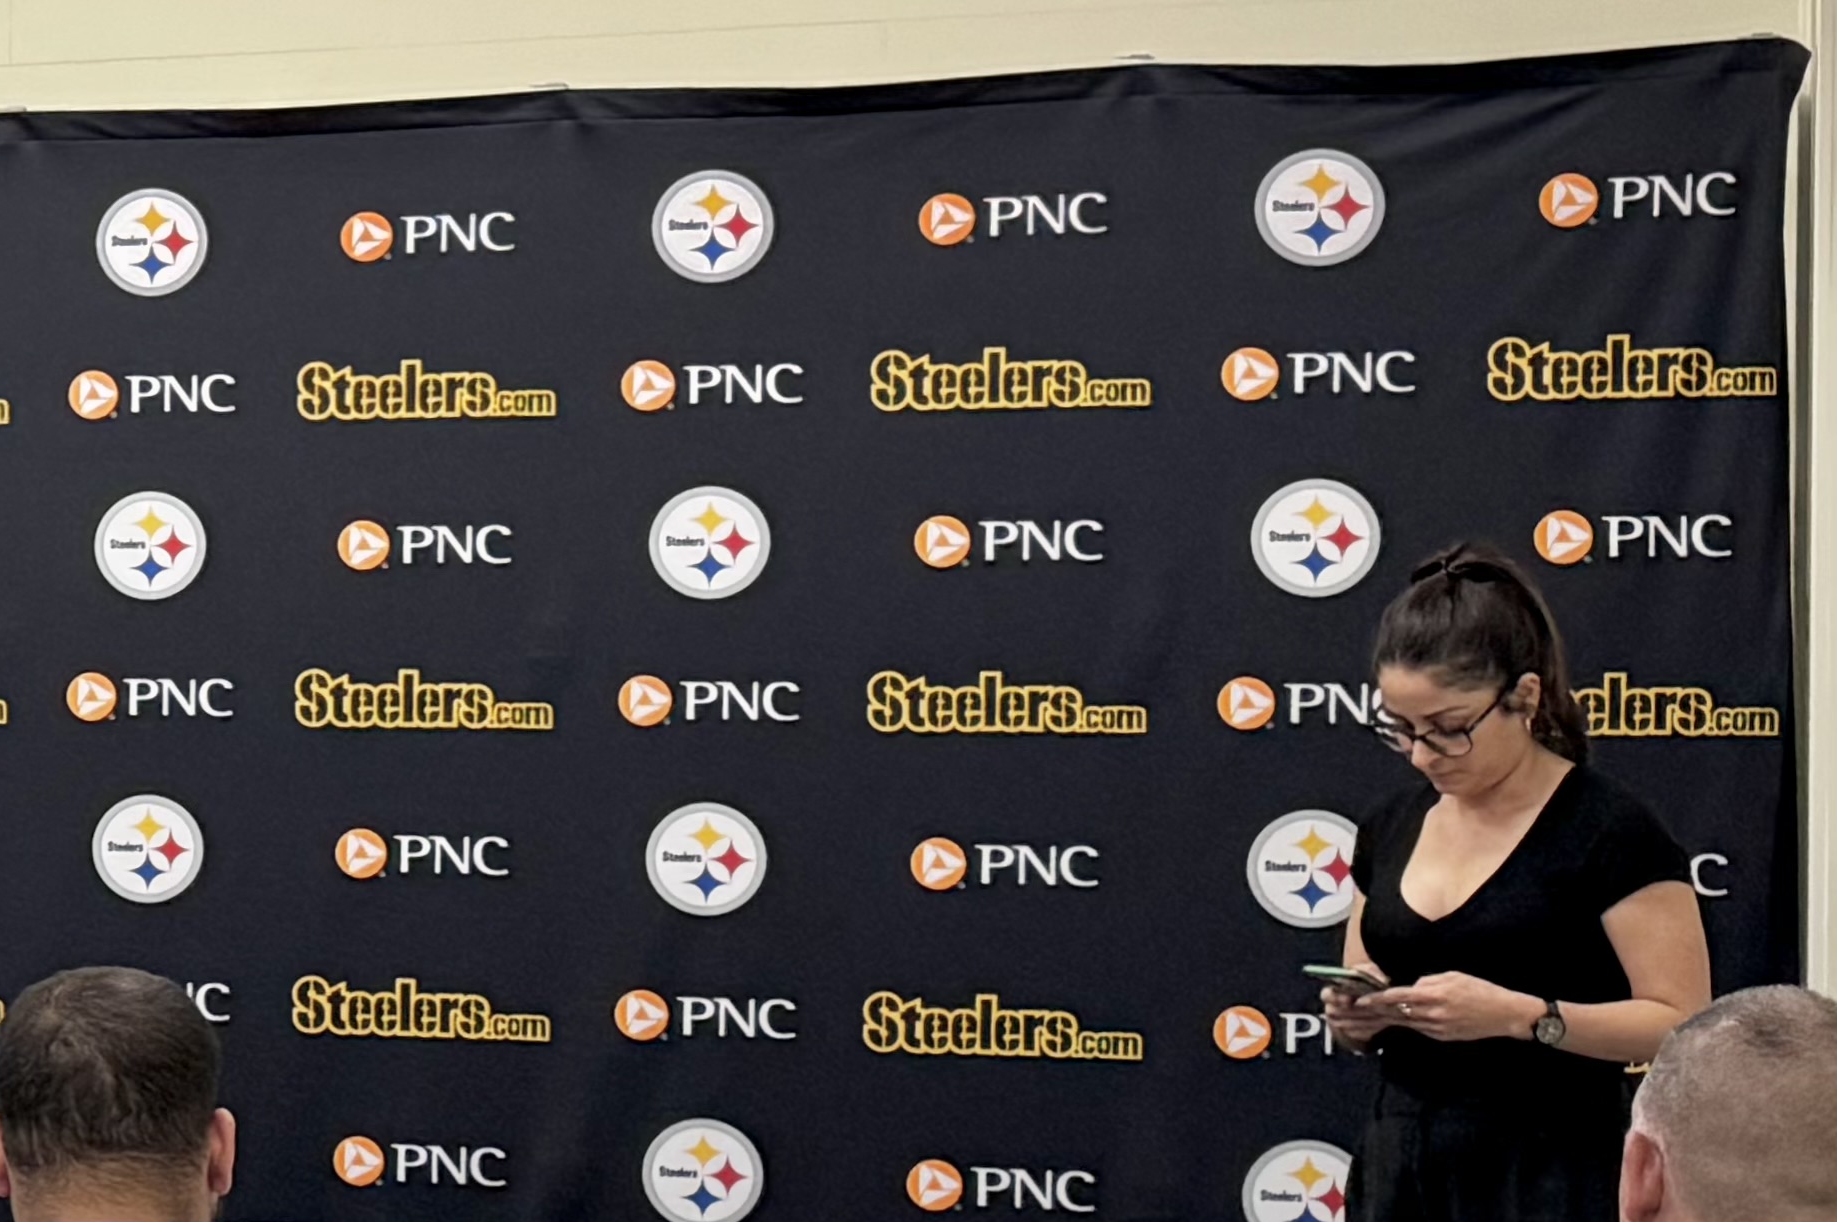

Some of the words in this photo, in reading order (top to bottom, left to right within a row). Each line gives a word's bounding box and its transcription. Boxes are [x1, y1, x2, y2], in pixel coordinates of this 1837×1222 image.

[984, 192, 1107, 236] PNC
[1272, 199, 1317, 213] Steelers
[1610, 172, 1735, 218] PNC
[111, 235, 150, 247] Steelers
[402, 212, 515, 253] PNC
[668, 218, 710, 232] Steelers
[684, 363, 803, 404] PNC
[872, 347, 1152, 413] Steelers.com
[1288, 351, 1415, 393] PNC
[1488, 335, 1778, 402] Steelers.com
[126, 374, 235, 413] PNC
[298, 360, 558, 422] Steelers.com
[109, 538, 148, 550] Steelers
[398, 525, 511, 564] PNC
[665, 535, 707, 547] Steelers
[980, 520, 1103, 560] PNC
[1268, 530, 1313, 543] Steelers
[1603, 515, 1731, 557] PNC
[124, 679, 233, 716] PNC
[296, 670, 555, 730] Steelers.com
[681, 681, 799, 721] PNC
[870, 671, 1148, 735] Steelers.com
[1571, 672, 1781, 736] elers.com
[107, 840, 145, 853] Steelers
[395, 835, 508, 875] PNC
[662, 850, 704, 863] Steelers
[976, 845, 1098, 886] PNC
[1264, 859, 1308, 873] Steelers
[294, 977, 552, 1043] Steelers.com
[678, 997, 795, 1038] PNC
[865, 992, 1144, 1061] Steelers.com
[392, 1144, 505, 1186] PNC
[658, 1165, 700, 1179] Steelers
[972, 1168, 1094, 1211] PNC
[1260, 1189, 1301, 1203] Steelers
